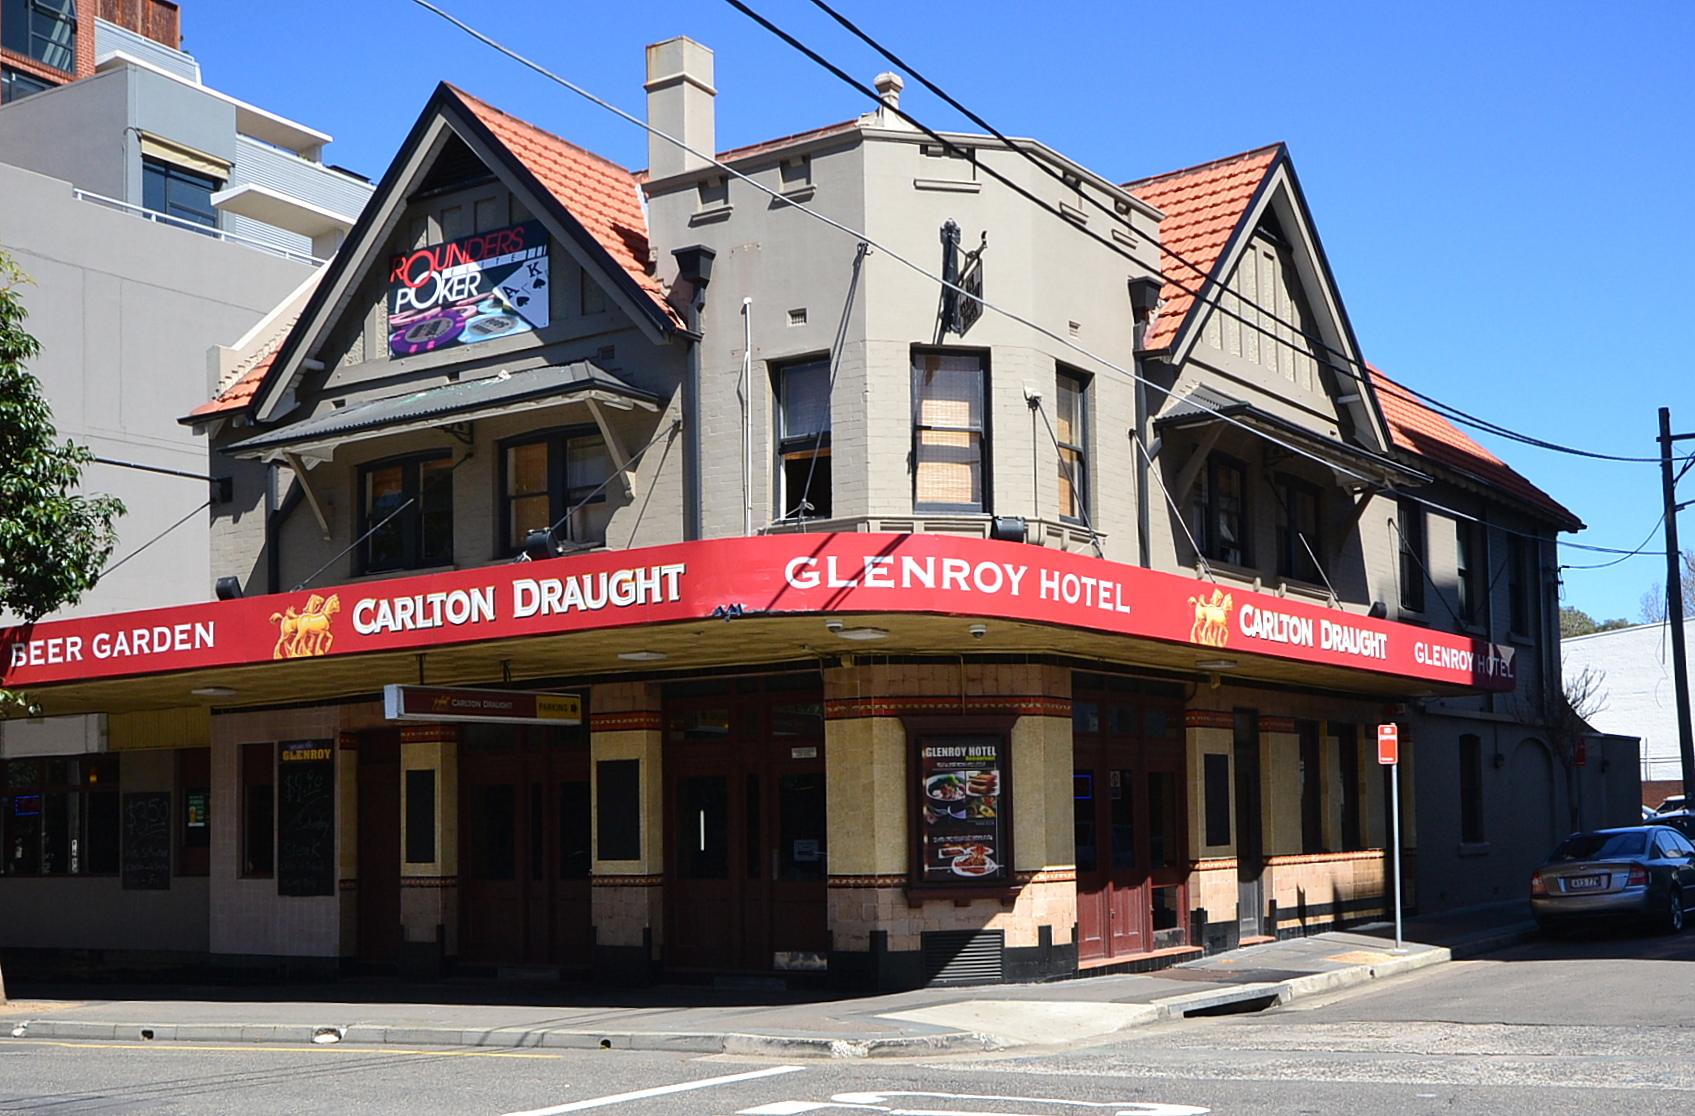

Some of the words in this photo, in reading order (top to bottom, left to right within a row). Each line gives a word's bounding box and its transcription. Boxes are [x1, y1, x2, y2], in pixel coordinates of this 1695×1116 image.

[390, 227, 525, 288] ROUNDERS
[395, 270, 481, 314] POKER
[352, 586, 496, 635] CARLTON
[512, 563, 686, 619] DRAUGHT
[784, 554, 1028, 596] GLENROY
[1039, 568, 1131, 614] HOTEL
[11, 636, 83, 667] BEER
[92, 621, 215, 659] GARDEN
[1239, 604, 1314, 647] CARLTON
[1320, 619, 1388, 660] DRAUGHT
[1414, 641, 1474, 672] GLENROY
[1477, 653, 1515, 679] HOTEL
[451, 698, 481, 708] CARLTON
[483, 700, 513, 710] DRAUGHT
[538, 702, 568, 713] PARKING
[282, 748, 331, 761] GLENROY
[925, 746, 967, 758] GLENROY
[968, 745, 997, 756] HOTEL
